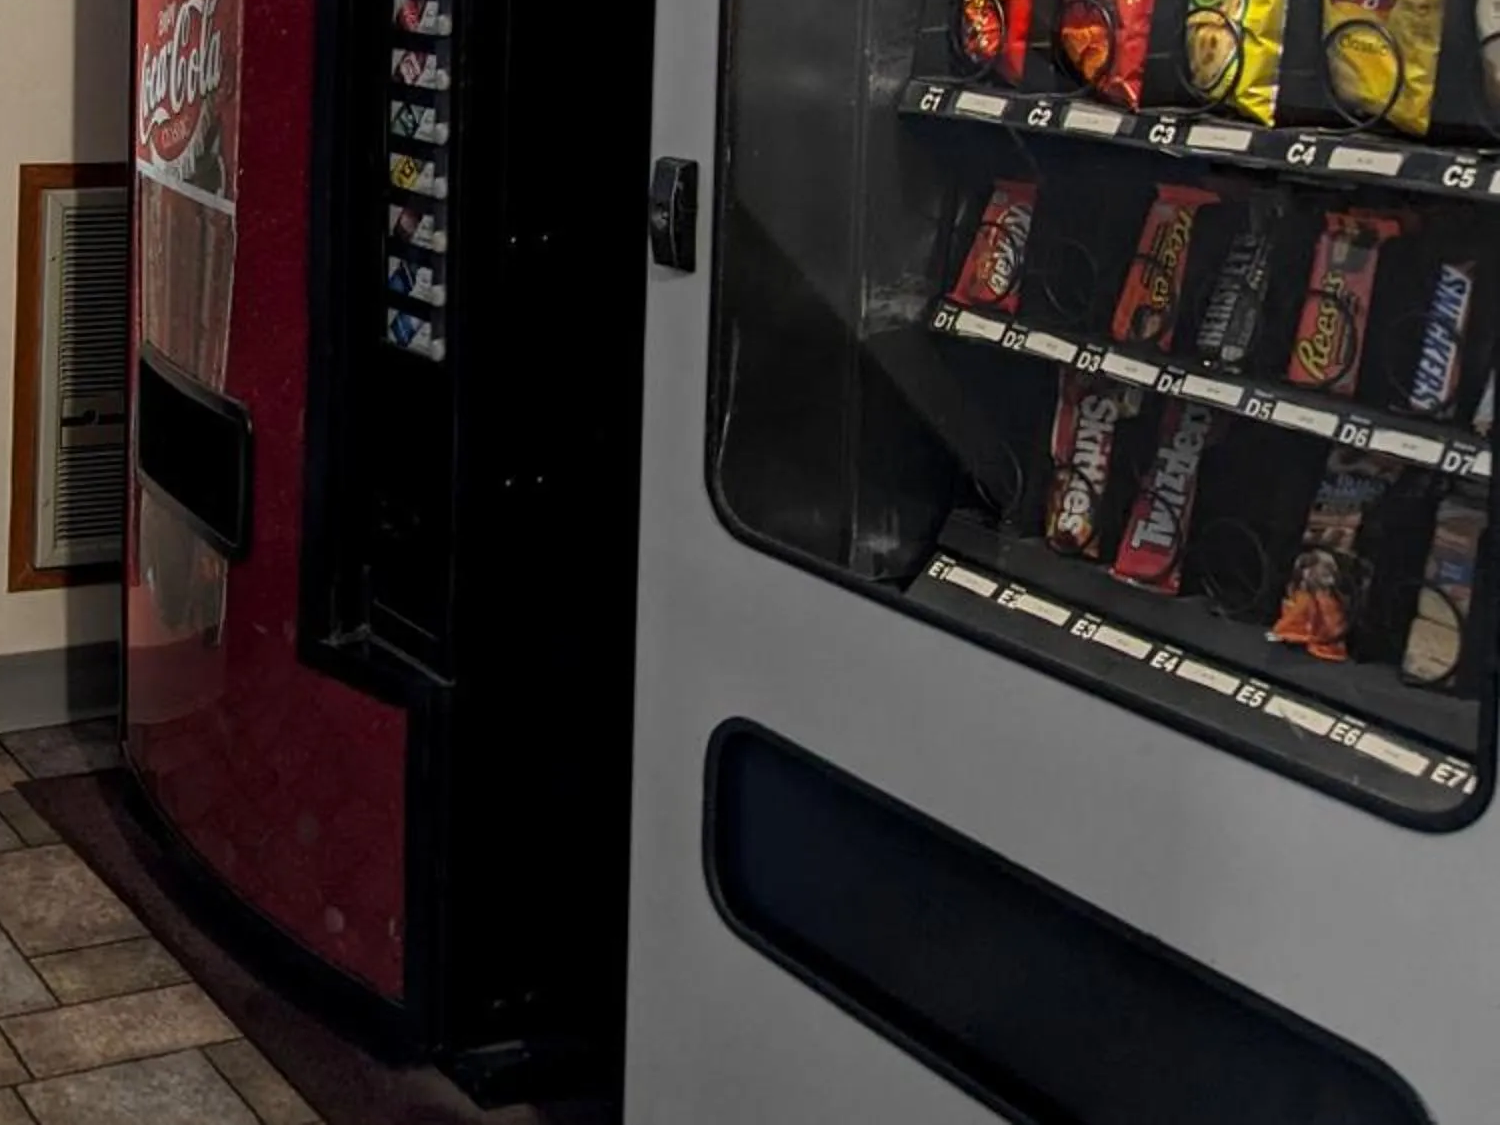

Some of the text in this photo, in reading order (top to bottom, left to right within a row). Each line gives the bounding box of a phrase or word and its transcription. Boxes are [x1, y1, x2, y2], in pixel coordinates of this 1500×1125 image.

[920, 93, 942, 112] C1
[1028, 108, 1053, 127] C2
[1149, 124, 1177, 145] C3
[1286, 143, 1317, 165] C4
[1442, 165, 1478, 188] C5
[933, 312, 955, 331] D1
[1002, 330, 1025, 350] D2
[1077, 351, 1101, 373] D3
[1156, 374, 1184, 395] D4
[1245, 398, 1274, 421] D5
[1339, 423, 1368, 447] D6
[1442, 451, 1476, 475] D7
[928, 561, 951, 581] E1
[1070, 619, 1095, 639] E3
[1150, 651, 1180, 673] E4
[1235, 686, 1266, 708] E5
[1329, 723, 1361, 746] E6
[1430, 763, 1468, 788] E7
